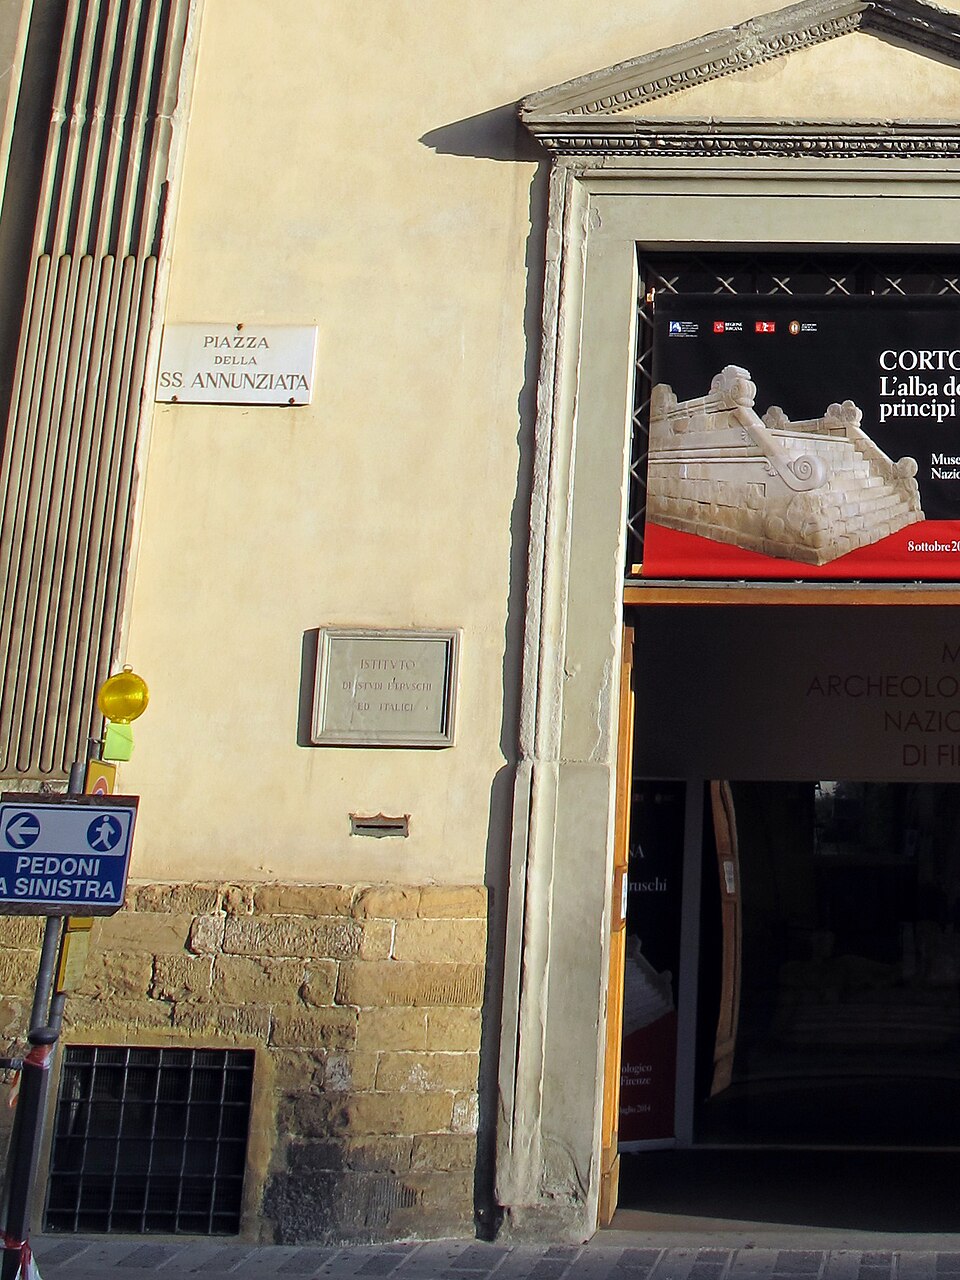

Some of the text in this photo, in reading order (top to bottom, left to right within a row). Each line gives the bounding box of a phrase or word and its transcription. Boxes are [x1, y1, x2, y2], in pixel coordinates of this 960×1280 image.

[203, 336, 269, 349] PIAZZA
[214, 355, 258, 365] DELLA
[160, 371, 310, 391] SS. ANNUNZIATA
[879, 376, 939, 396] L'alba
[879, 399, 956, 423] principi
[915, 540, 951, 552] ottobre
[902, 744, 927, 767] DI
[15, 856, 101, 877] PEDONI
[14, 877, 116, 899] SINISTRA
